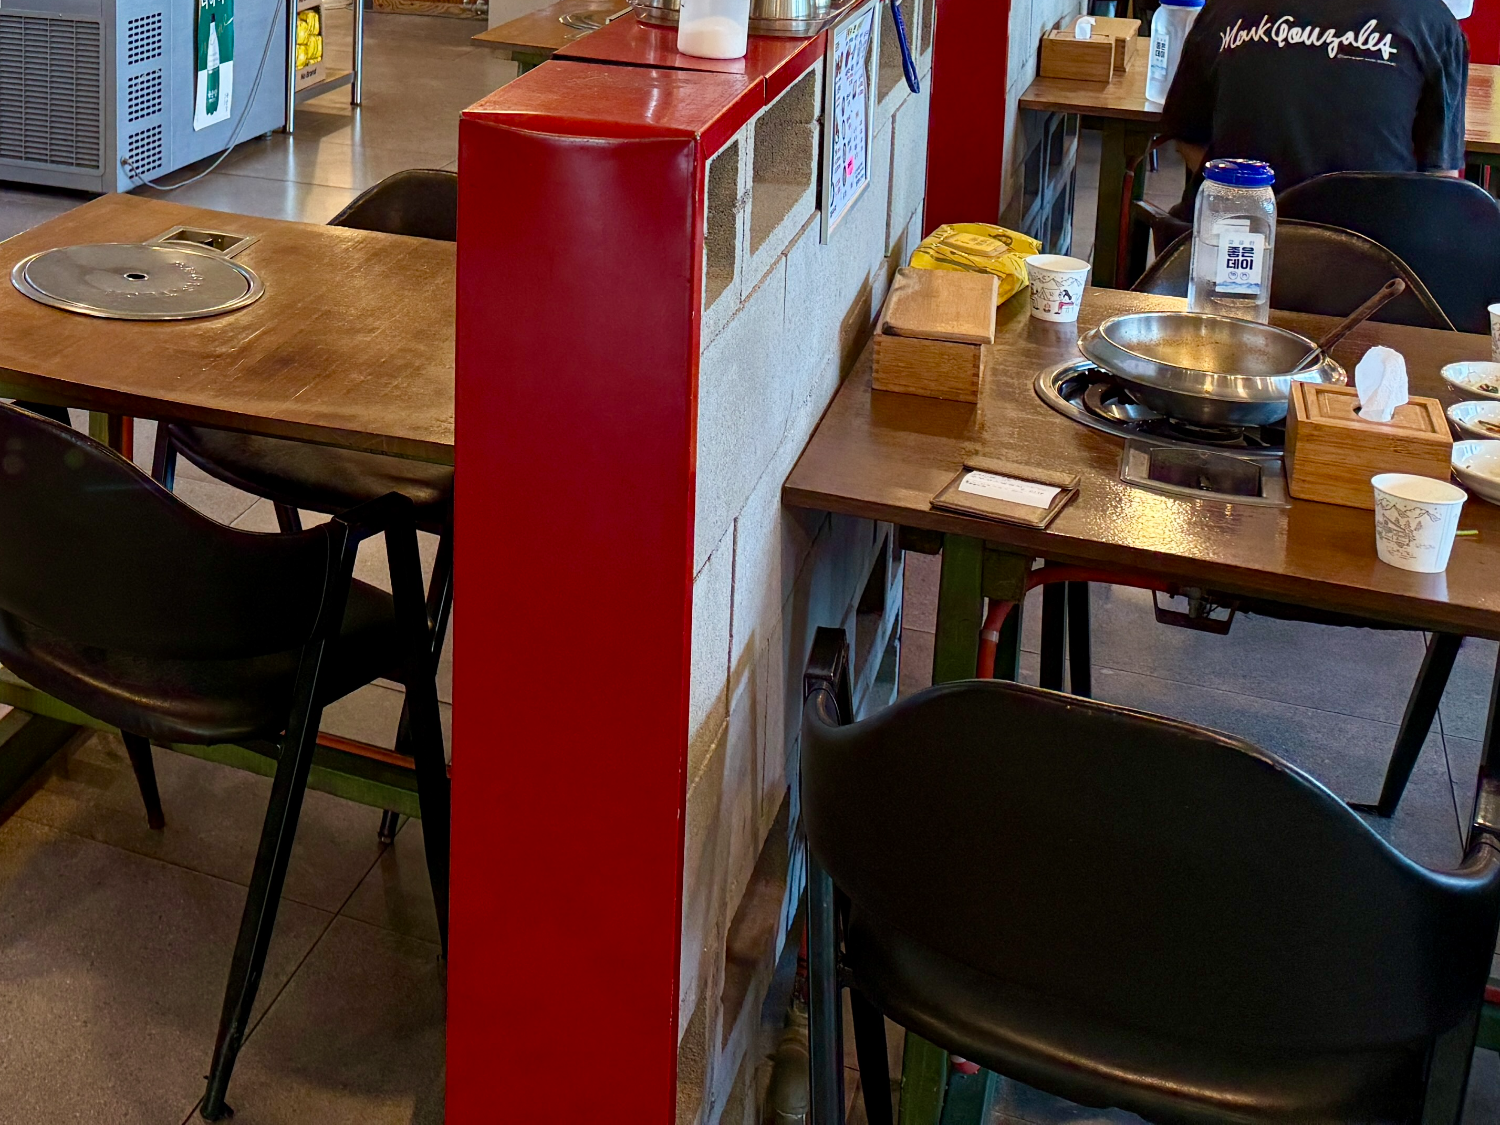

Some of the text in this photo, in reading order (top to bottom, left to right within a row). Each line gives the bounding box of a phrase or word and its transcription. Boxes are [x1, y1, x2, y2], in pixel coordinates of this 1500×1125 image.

[1220, 14, 1271, 52] Mark
[1227, 246, 1255, 258] 좋은
[1226, 258, 1254, 270] 데이
